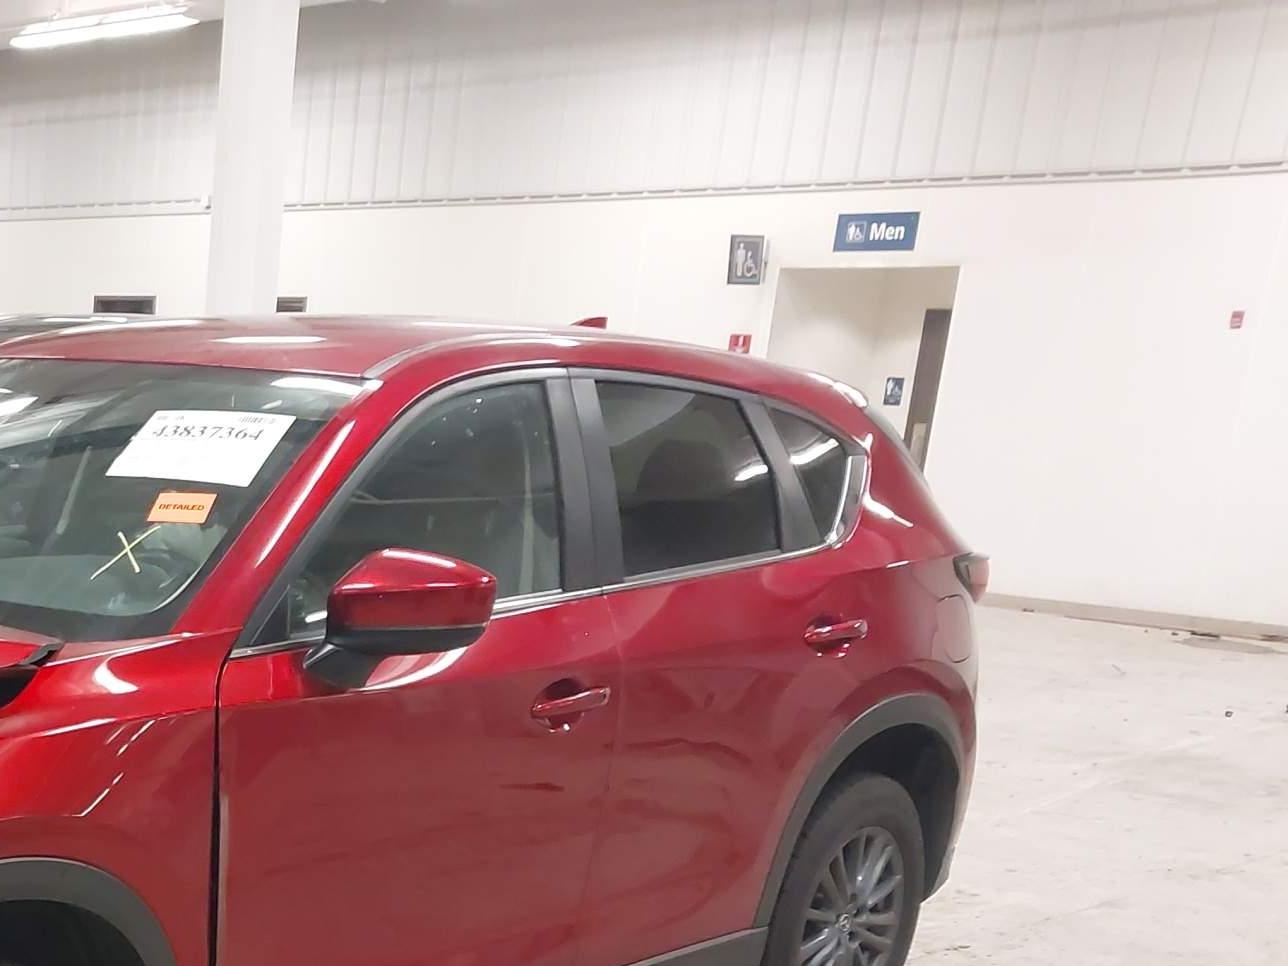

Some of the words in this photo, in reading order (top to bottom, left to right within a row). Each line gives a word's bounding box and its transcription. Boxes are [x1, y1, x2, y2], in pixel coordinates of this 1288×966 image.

[869, 222, 906, 241] Men
[152, 424, 265, 441] 43837364
[158, 501, 206, 512] DETAILED
